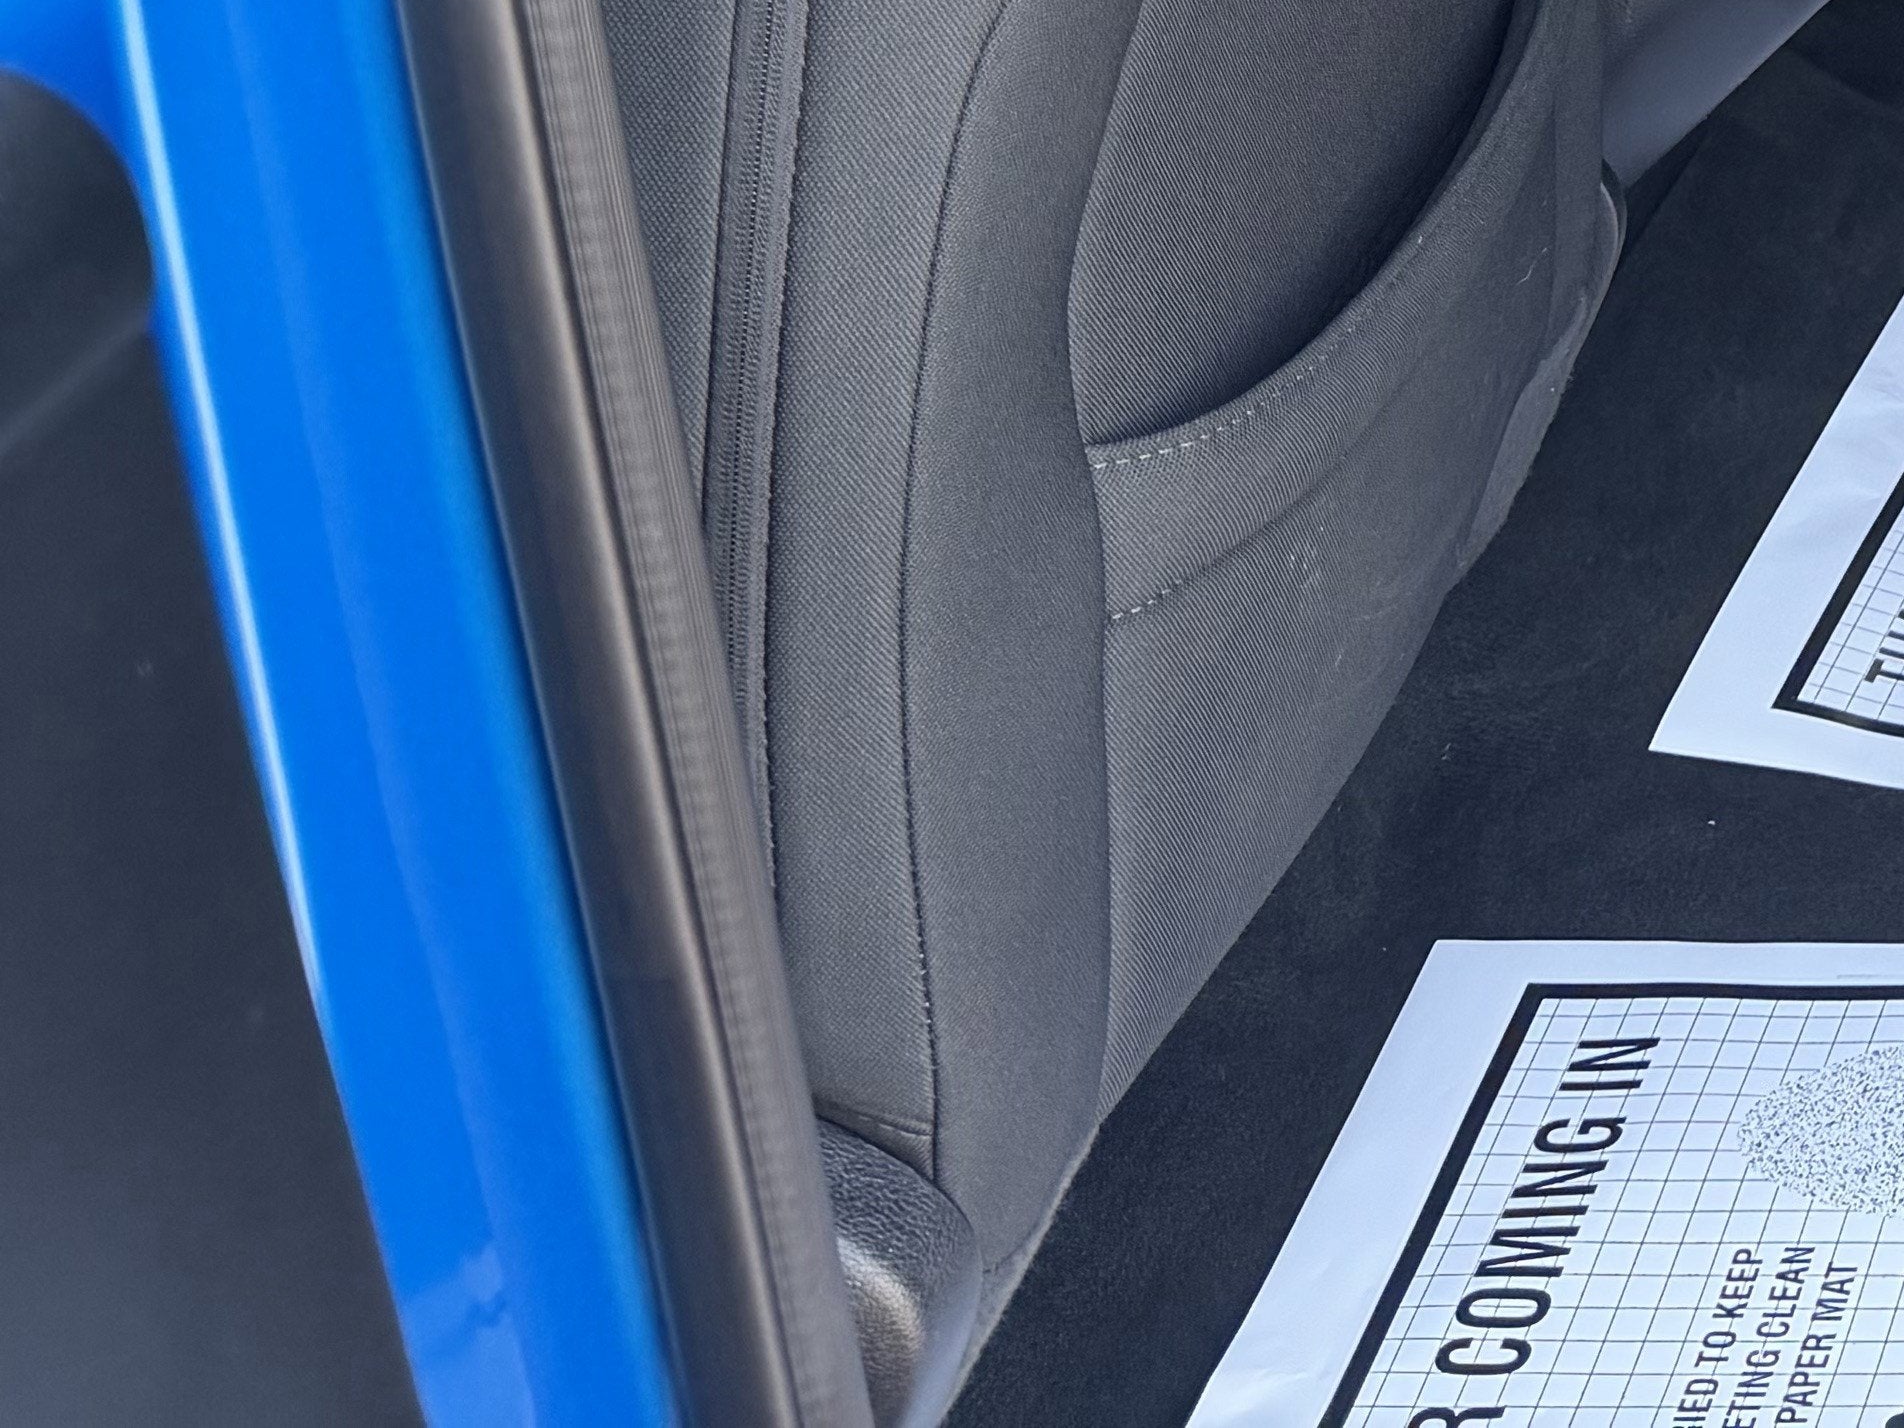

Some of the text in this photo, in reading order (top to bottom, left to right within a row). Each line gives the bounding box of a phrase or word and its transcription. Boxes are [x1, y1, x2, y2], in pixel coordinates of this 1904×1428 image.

[1434, 1116, 1627, 1376] COMING
[1558, 1037, 1661, 1092] IN
[1672, 1248, 1763, 1428] IED TO KEEP
[1721, 1246, 1816, 1428] ETING CLEAN
[1774, 1261, 1858, 1424] PAPER MAT
